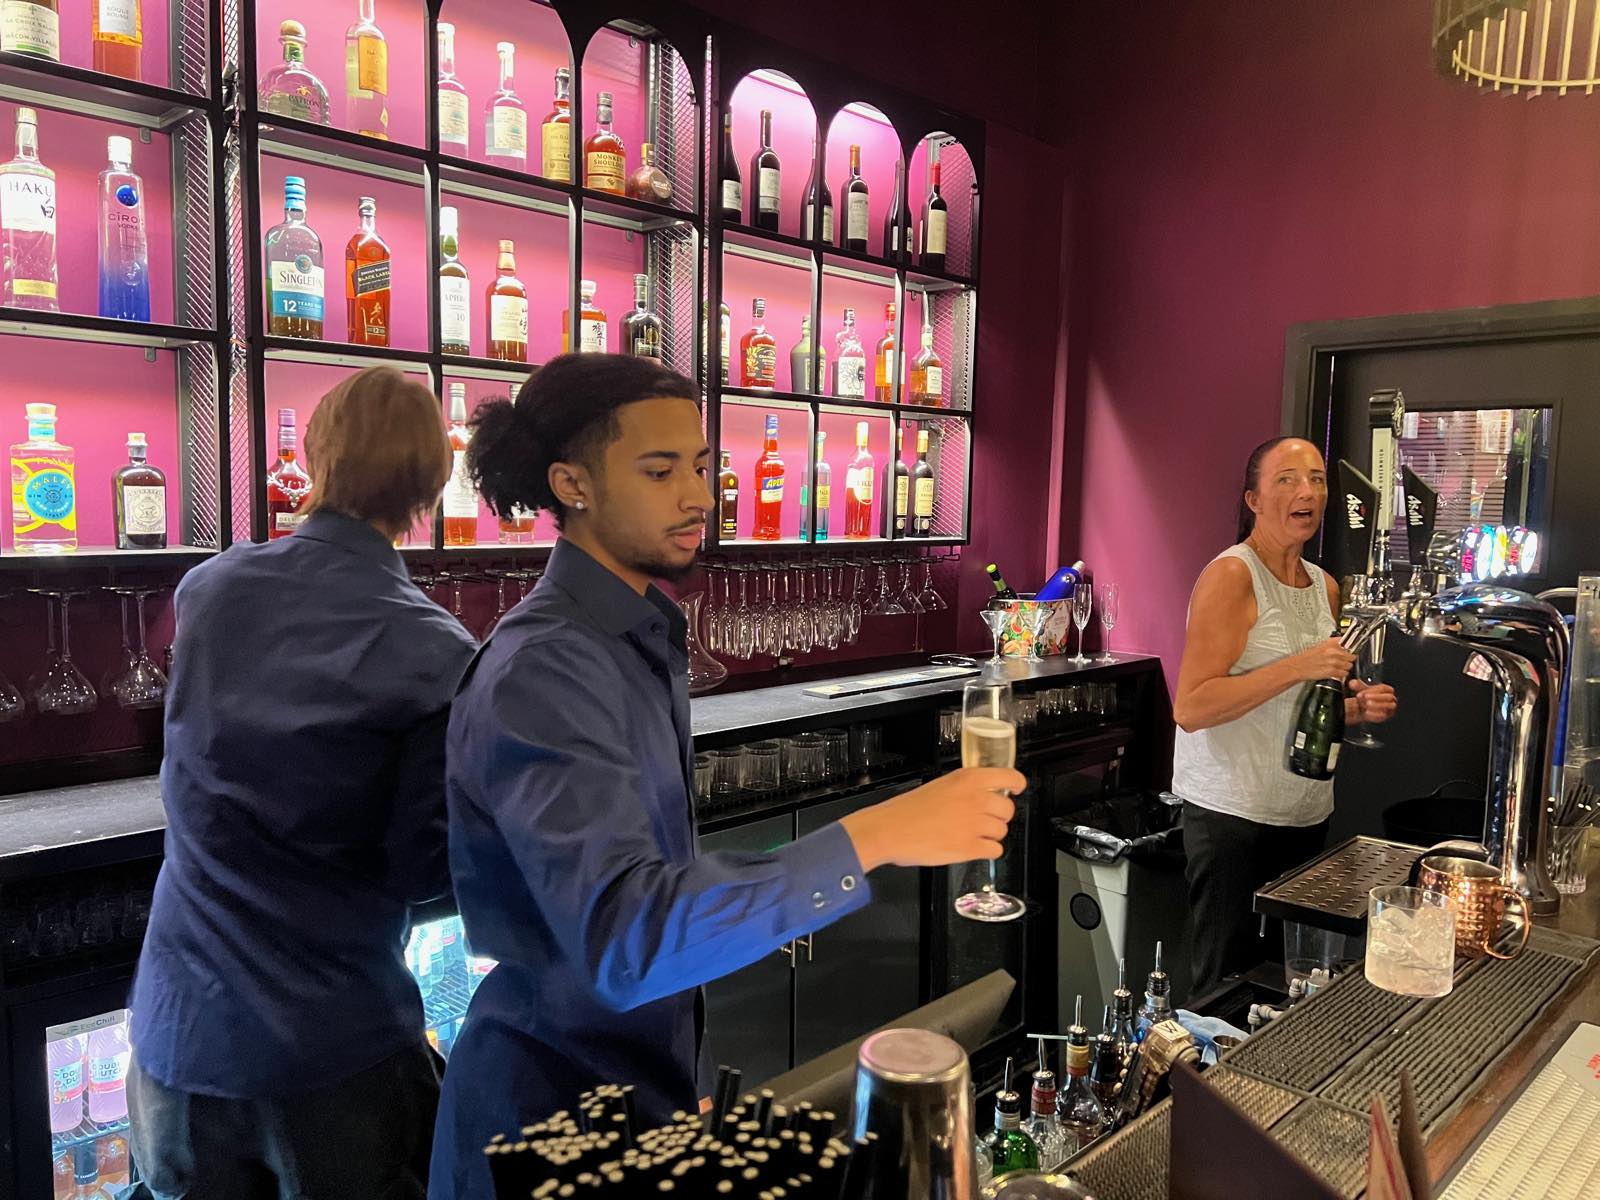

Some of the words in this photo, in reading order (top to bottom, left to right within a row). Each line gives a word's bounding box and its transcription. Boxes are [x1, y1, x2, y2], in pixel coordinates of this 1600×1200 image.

[283, 299, 297, 312] 12
[1346, 493, 1366, 529] Asahi
[1407, 495, 1424, 525] Asahi
[1593, 585, 1600, 600] f
[1156, 1021, 1178, 1034] W
